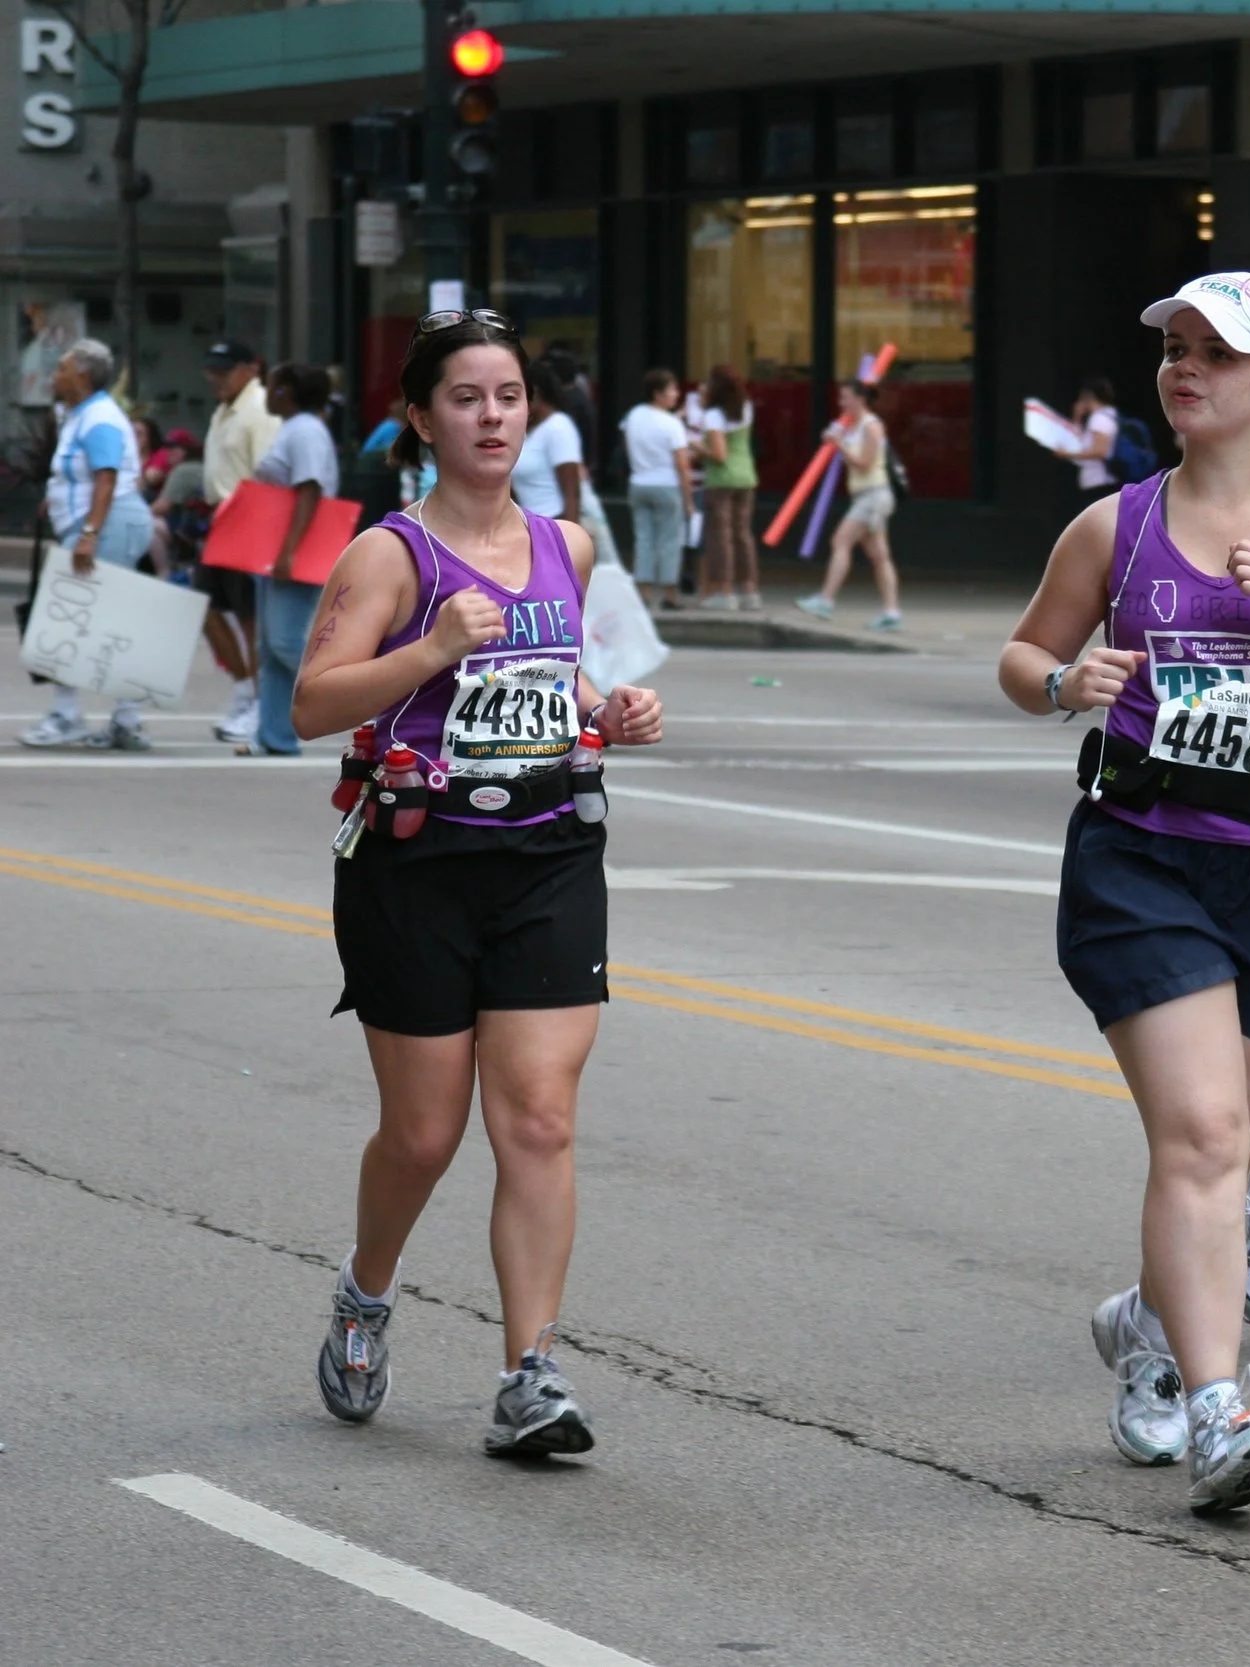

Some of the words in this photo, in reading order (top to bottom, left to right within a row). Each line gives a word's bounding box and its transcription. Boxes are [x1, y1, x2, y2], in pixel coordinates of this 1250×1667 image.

[1192, 642, 1207, 651] The
[1196, 651, 1244, 661] Lymphoma
[536, 669, 558, 681] Bank
[456, 687, 570, 740] 44339
[467, 745, 491, 757] 30th
[494, 742, 571, 756] ANNIVERSARY
